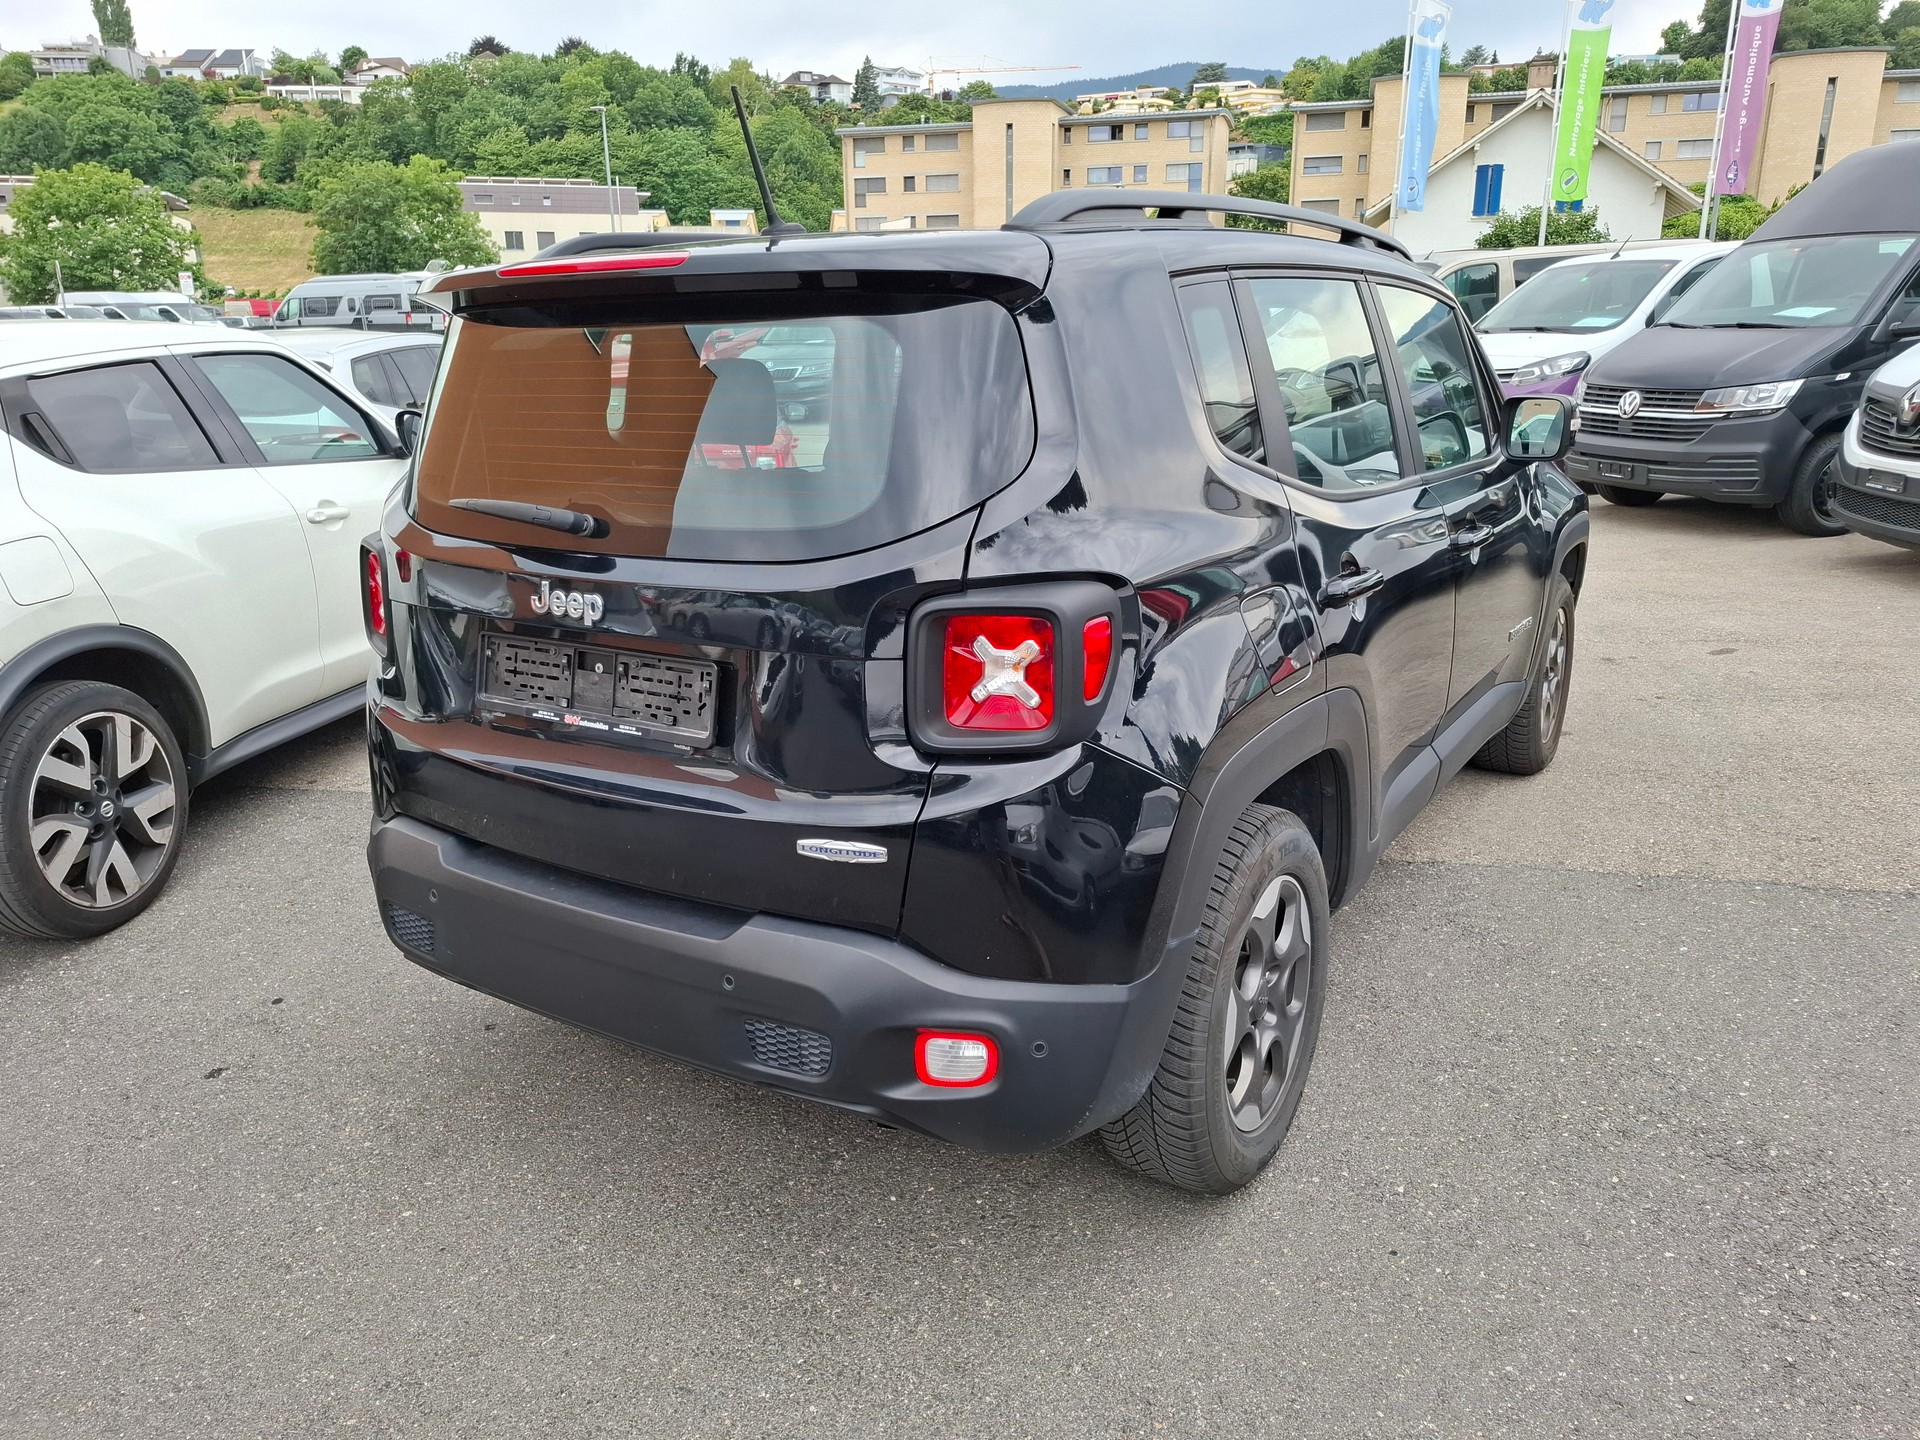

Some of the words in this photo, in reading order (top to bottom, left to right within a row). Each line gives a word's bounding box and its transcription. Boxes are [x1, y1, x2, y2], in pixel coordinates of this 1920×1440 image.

[1418, 54, 1432, 98] Pression
[1742, 25, 1762, 105] Automatique
[1569, 98, 1584, 157] Nettoyage
[1578, 44, 1592, 95] Intérieur
[530, 580, 604, 627] Jeep
[801, 844, 882, 859] LONGITUDE
